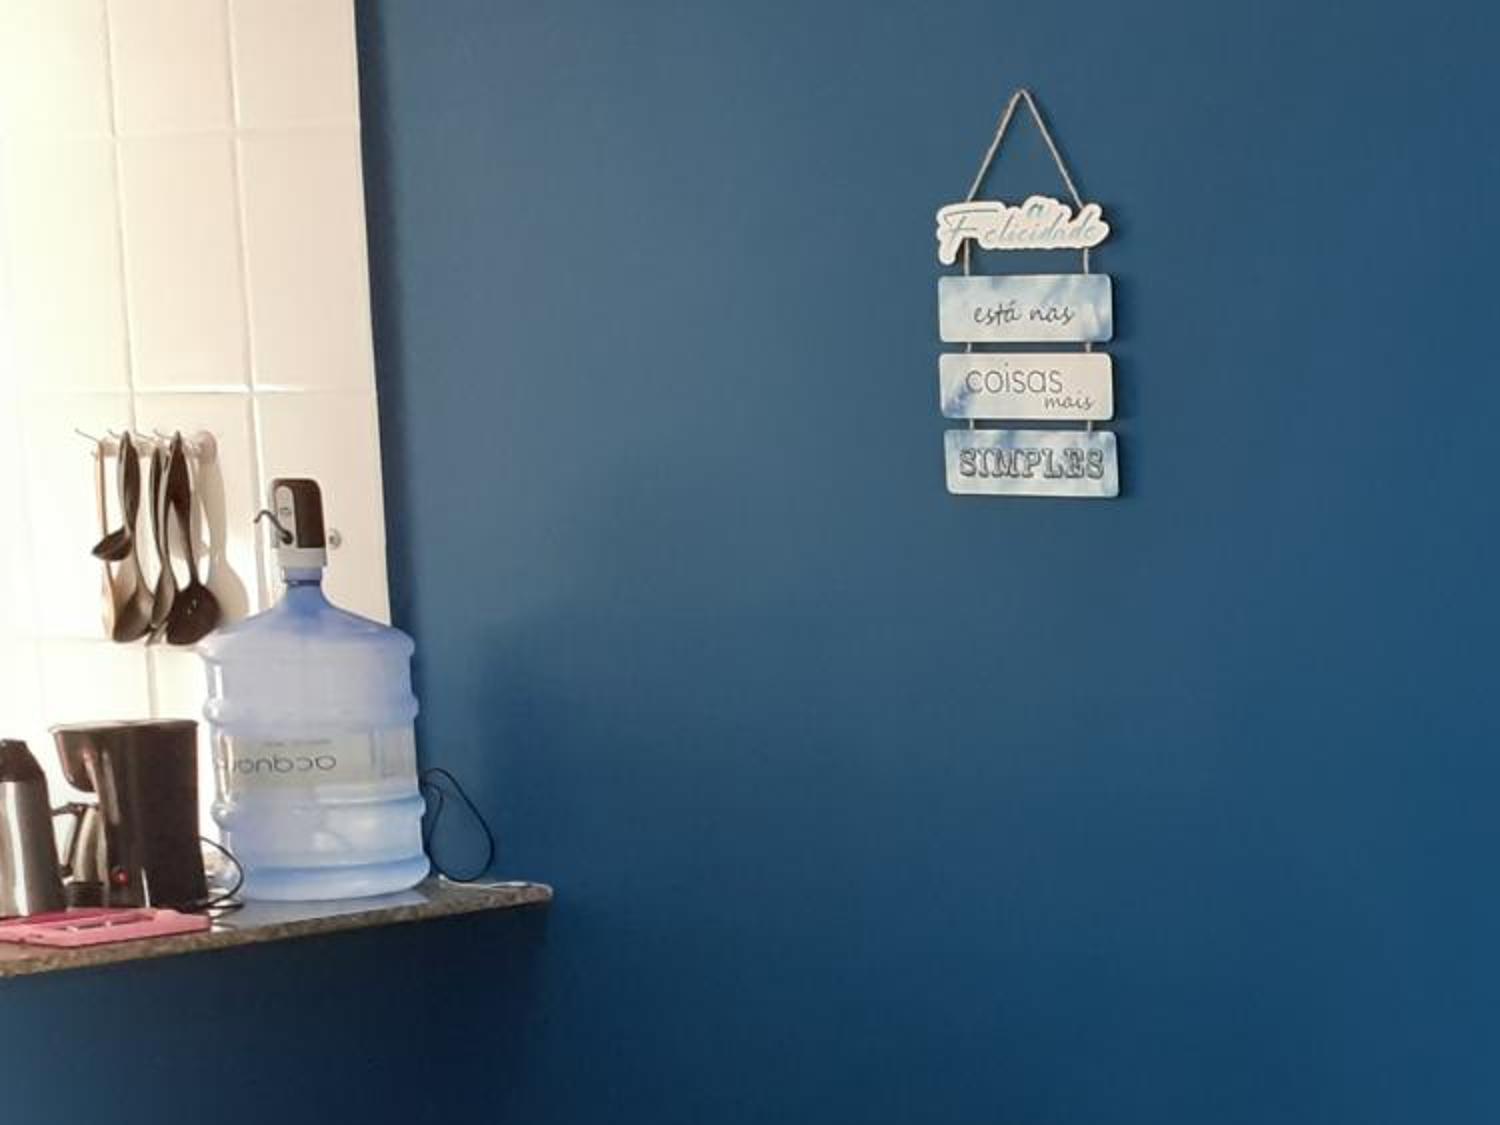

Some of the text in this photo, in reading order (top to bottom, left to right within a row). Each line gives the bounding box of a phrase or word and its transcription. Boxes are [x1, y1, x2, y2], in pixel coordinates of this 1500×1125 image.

[943, 209, 1098, 243] Felicidade
[973, 299, 1076, 327] está nas
[965, 361, 1063, 395] coisas
[1043, 390, 1096, 410] mais
[958, 446, 1106, 480] SIMPLES
